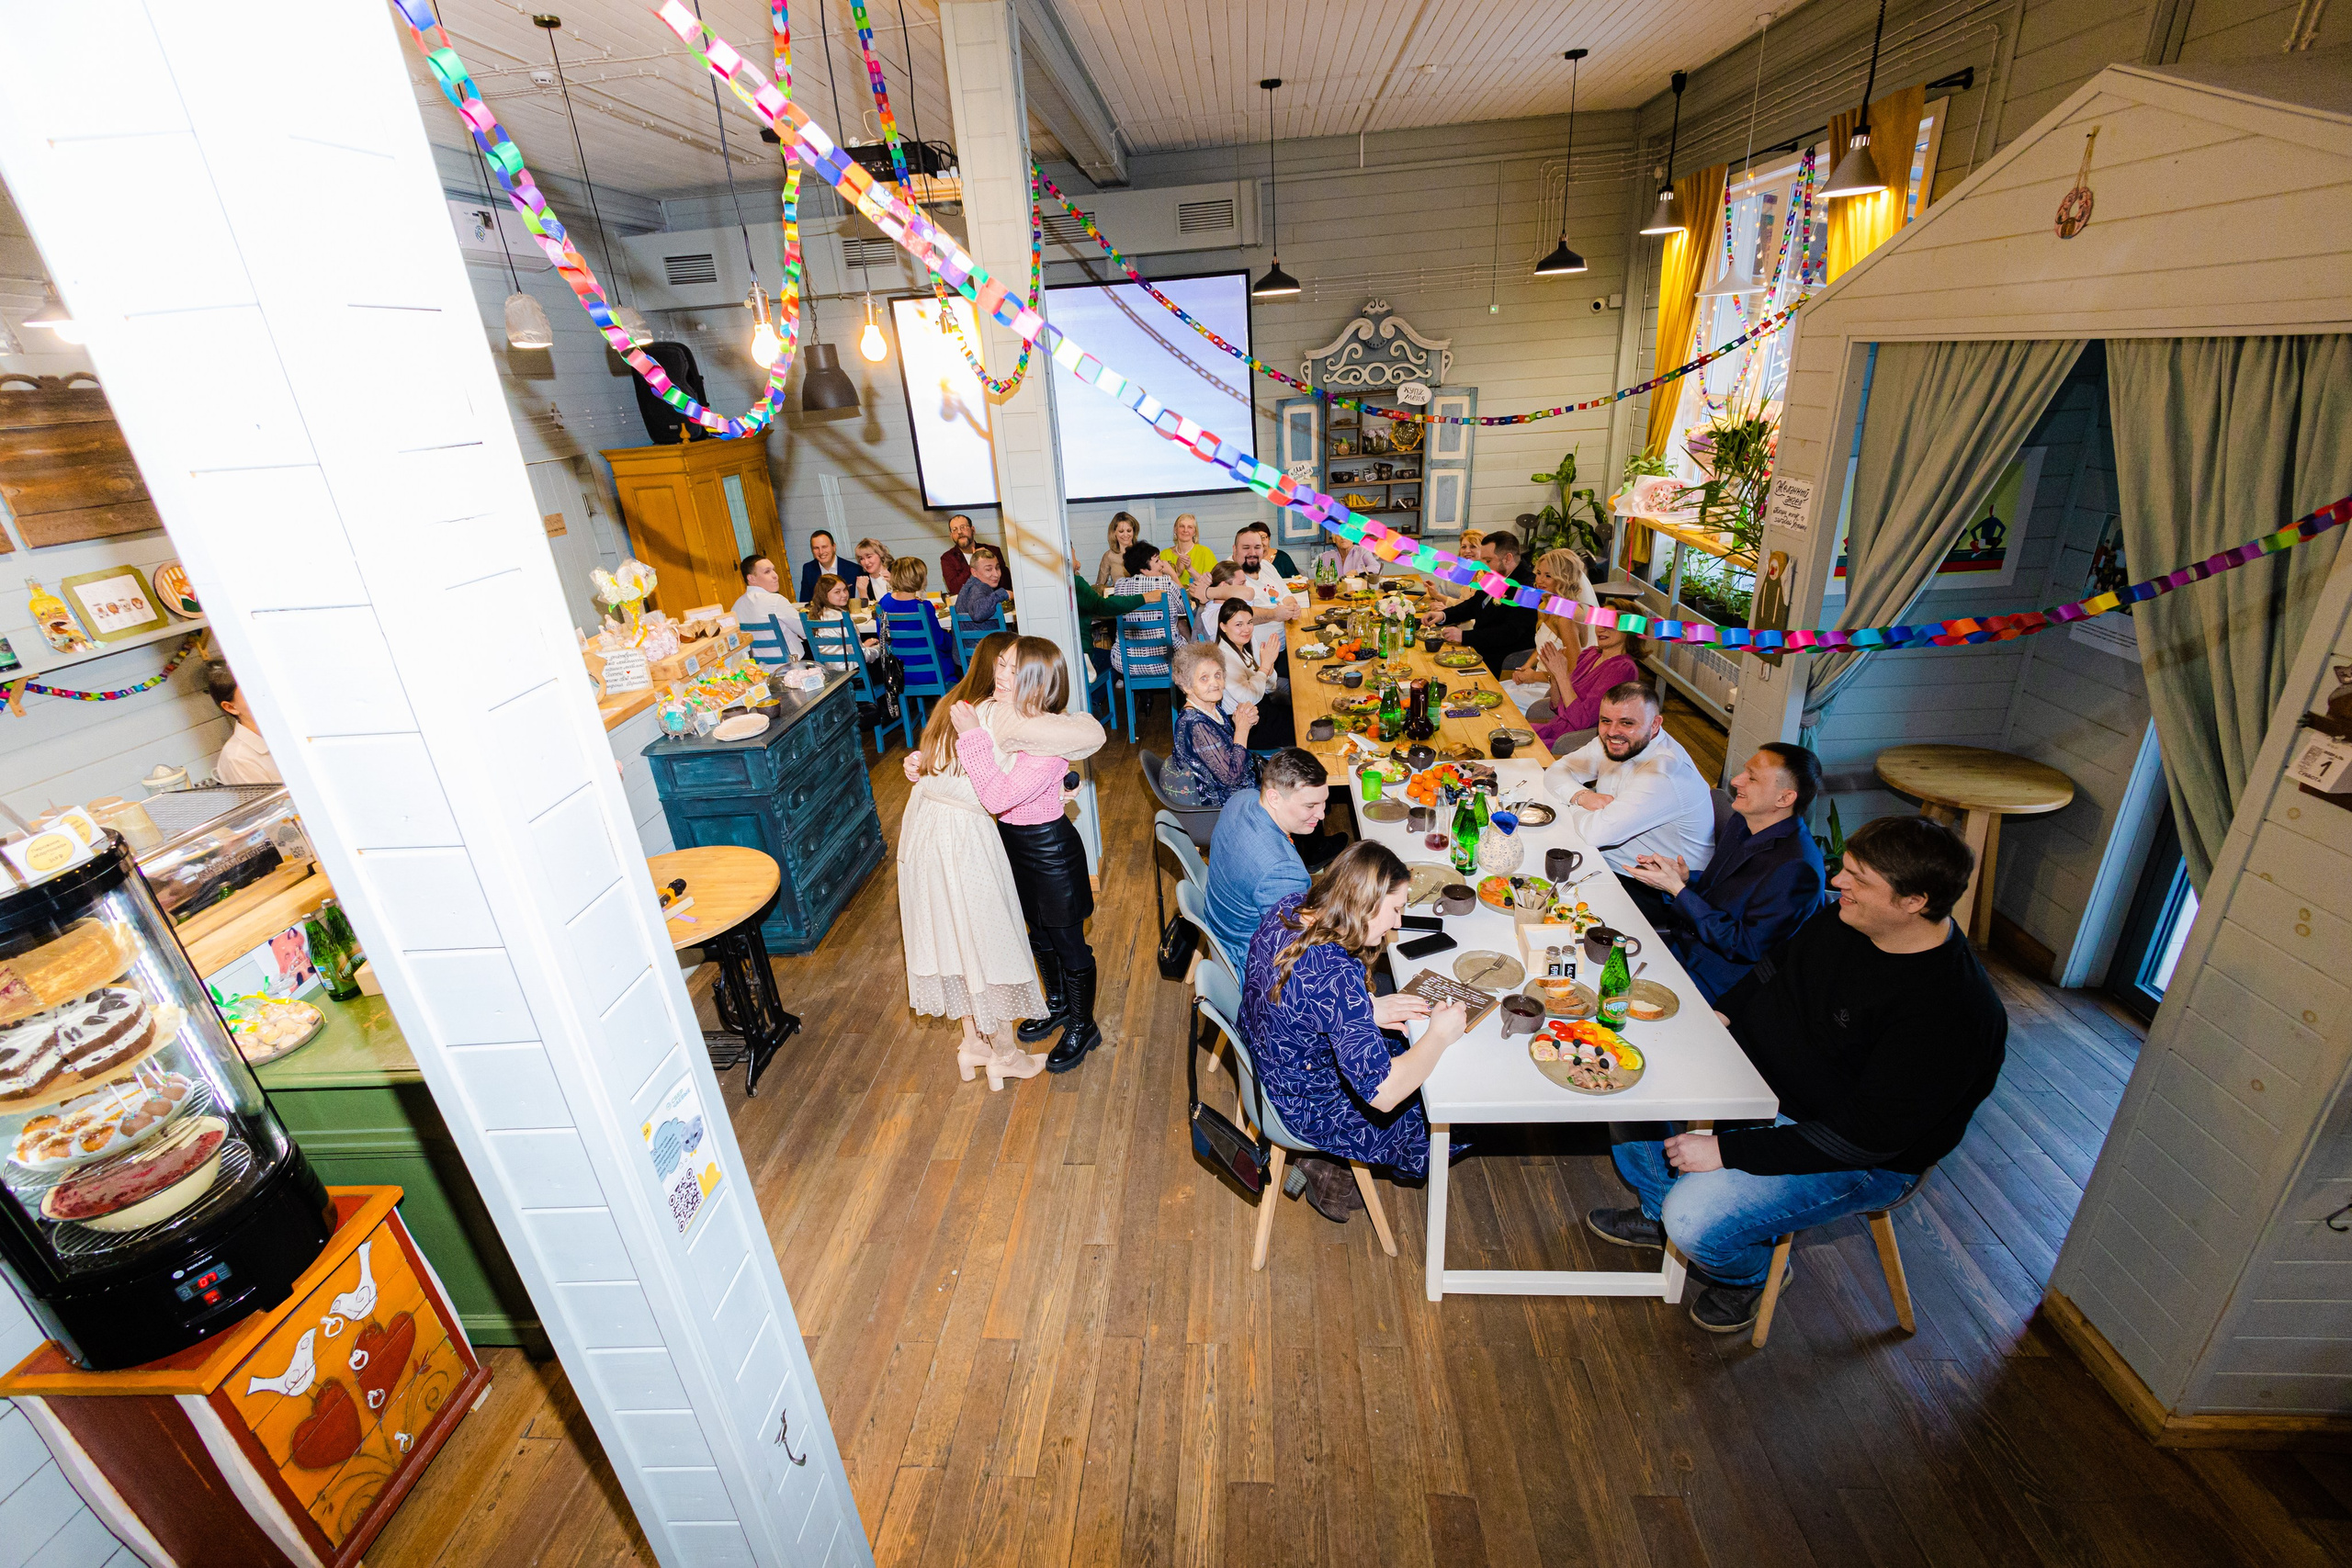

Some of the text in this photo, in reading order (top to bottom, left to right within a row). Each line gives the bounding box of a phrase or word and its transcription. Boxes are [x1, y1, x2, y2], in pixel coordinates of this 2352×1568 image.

[1403, 386, 1424, 395] КУПИ
[1405, 393, 1426, 402] МЕНЯ
[2319, 761, 2333, 777] 1
[2298, 770, 2322, 783] СУББОТА
